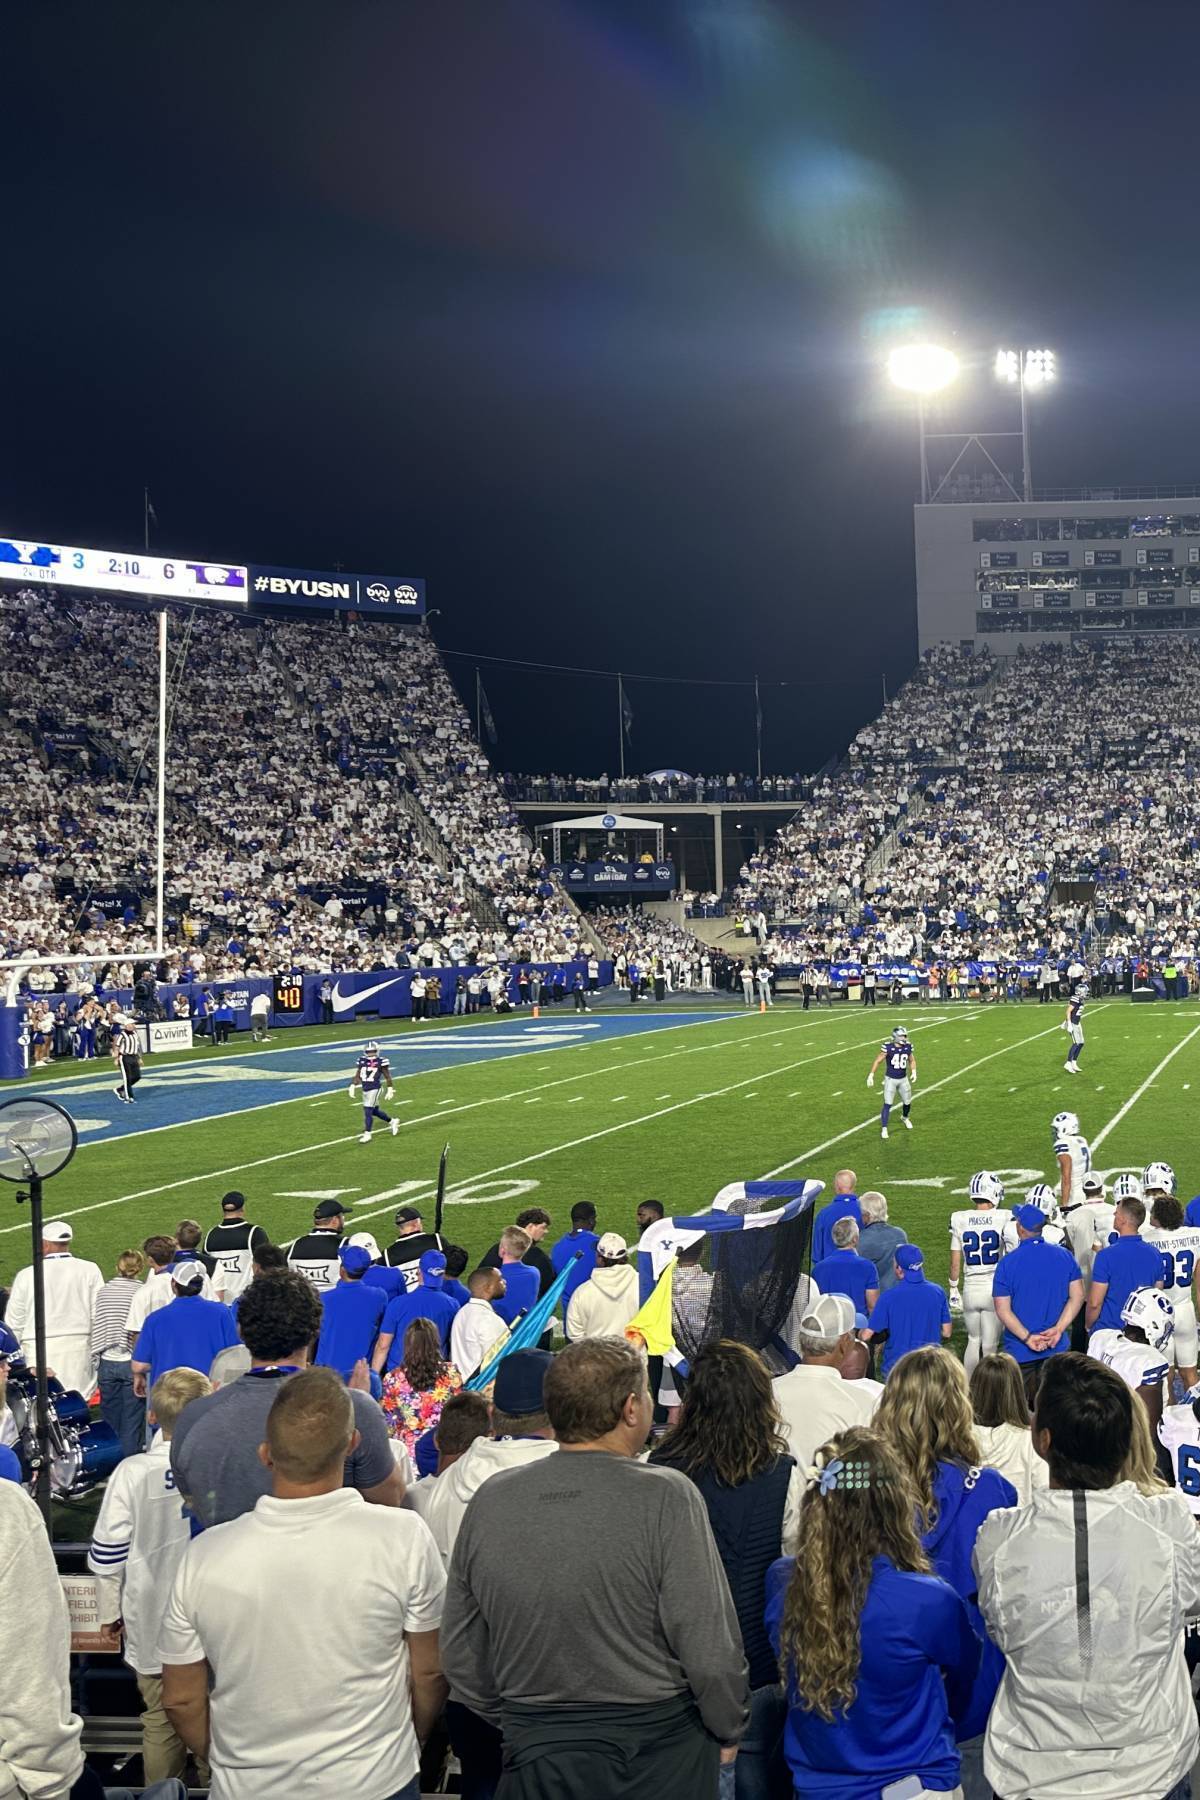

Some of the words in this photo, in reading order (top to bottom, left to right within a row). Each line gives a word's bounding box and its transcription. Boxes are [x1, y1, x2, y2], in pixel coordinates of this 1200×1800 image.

[72, 553, 84, 569] 3
[108, 558, 140, 575] 2:10
[163, 563, 175, 579] 6
[254, 576, 350, 599] #BYUSN
[1059, 874, 1079, 883] Portal
[281, 975, 302, 987] 2:10
[277, 987, 300, 1009] 40
[163, 1027, 188, 1039] vivint
[360, 1067, 378, 1082] 47
[962, 1229, 1000, 1266] 22
